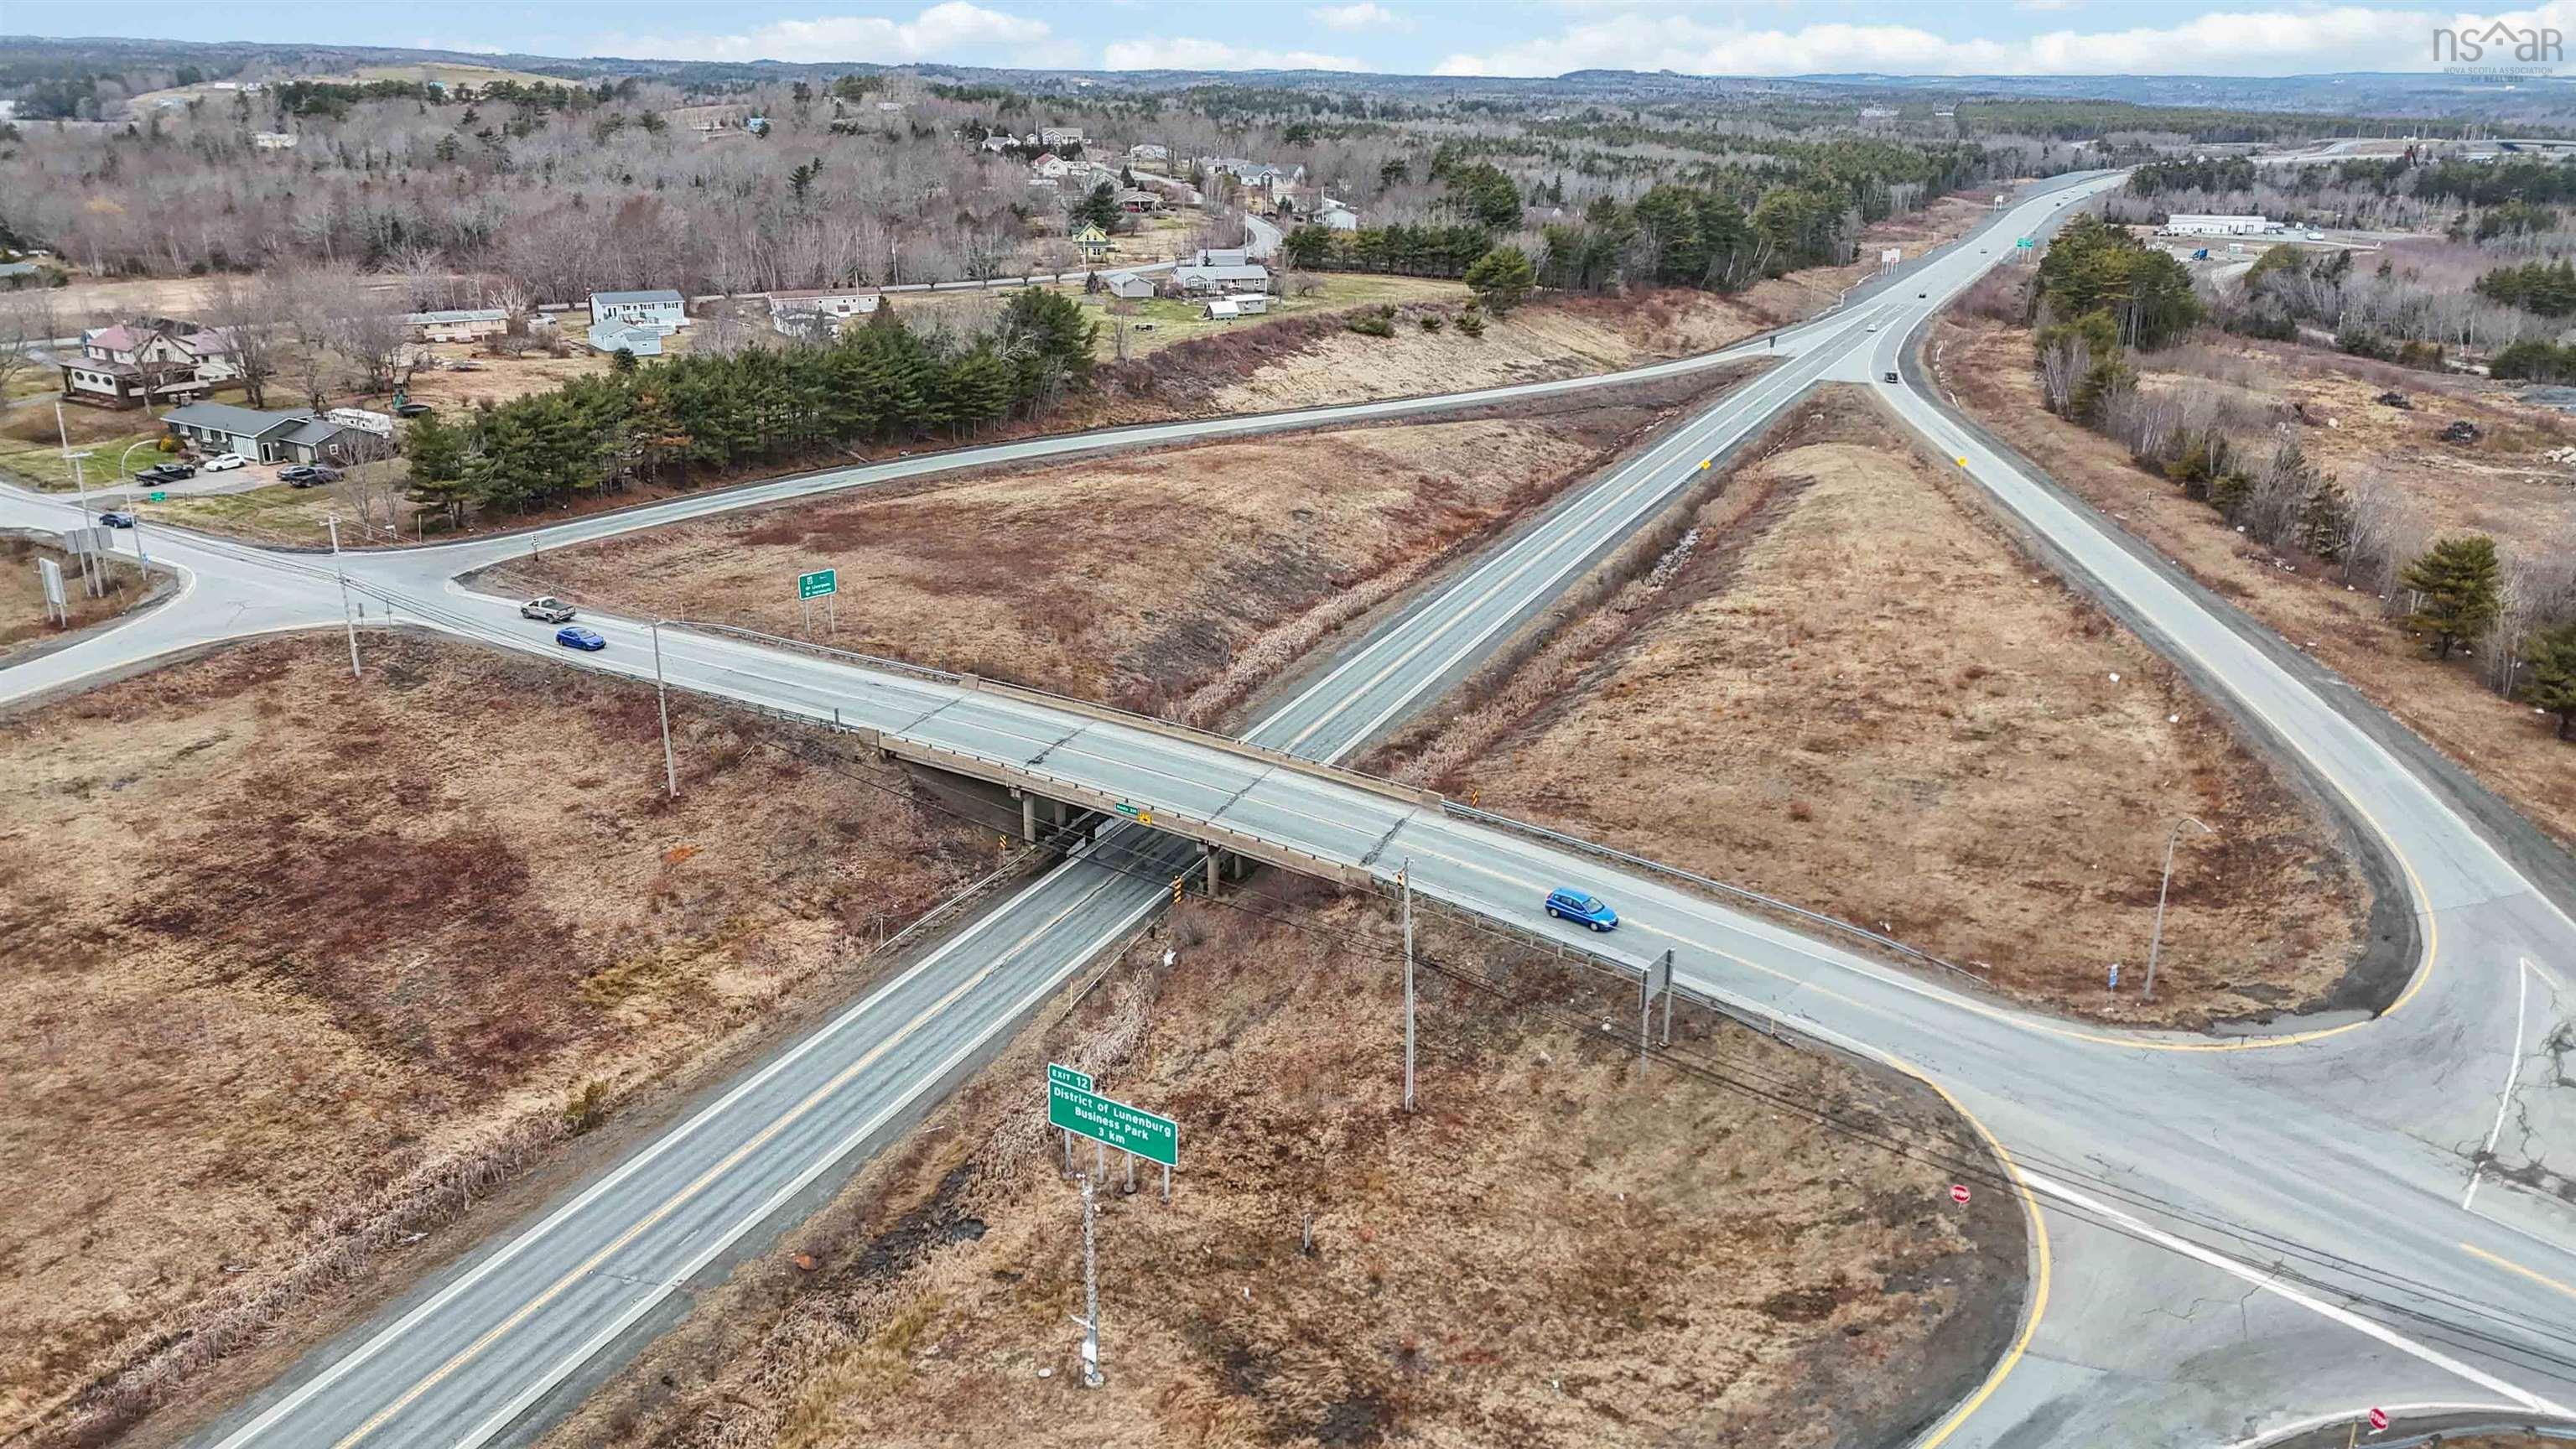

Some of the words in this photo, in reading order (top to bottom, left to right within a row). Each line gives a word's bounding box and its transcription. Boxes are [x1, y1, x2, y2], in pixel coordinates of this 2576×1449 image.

[1052, 1069, 1070, 1081] EXIT
[1076, 1077, 1088, 1089] 12
[1053, 1087, 1093, 1109] District
[1097, 1103, 1109, 1114] of
[1113, 1107, 1171, 1138] Lunenburg
[1074, 1106, 1120, 1130] Business
[1124, 1124, 1149, 1140] Park
[1098, 1126, 1104, 1137] 3
[1109, 1130, 1125, 1145] km
[2371, 1410, 2386, 1426] STOP
